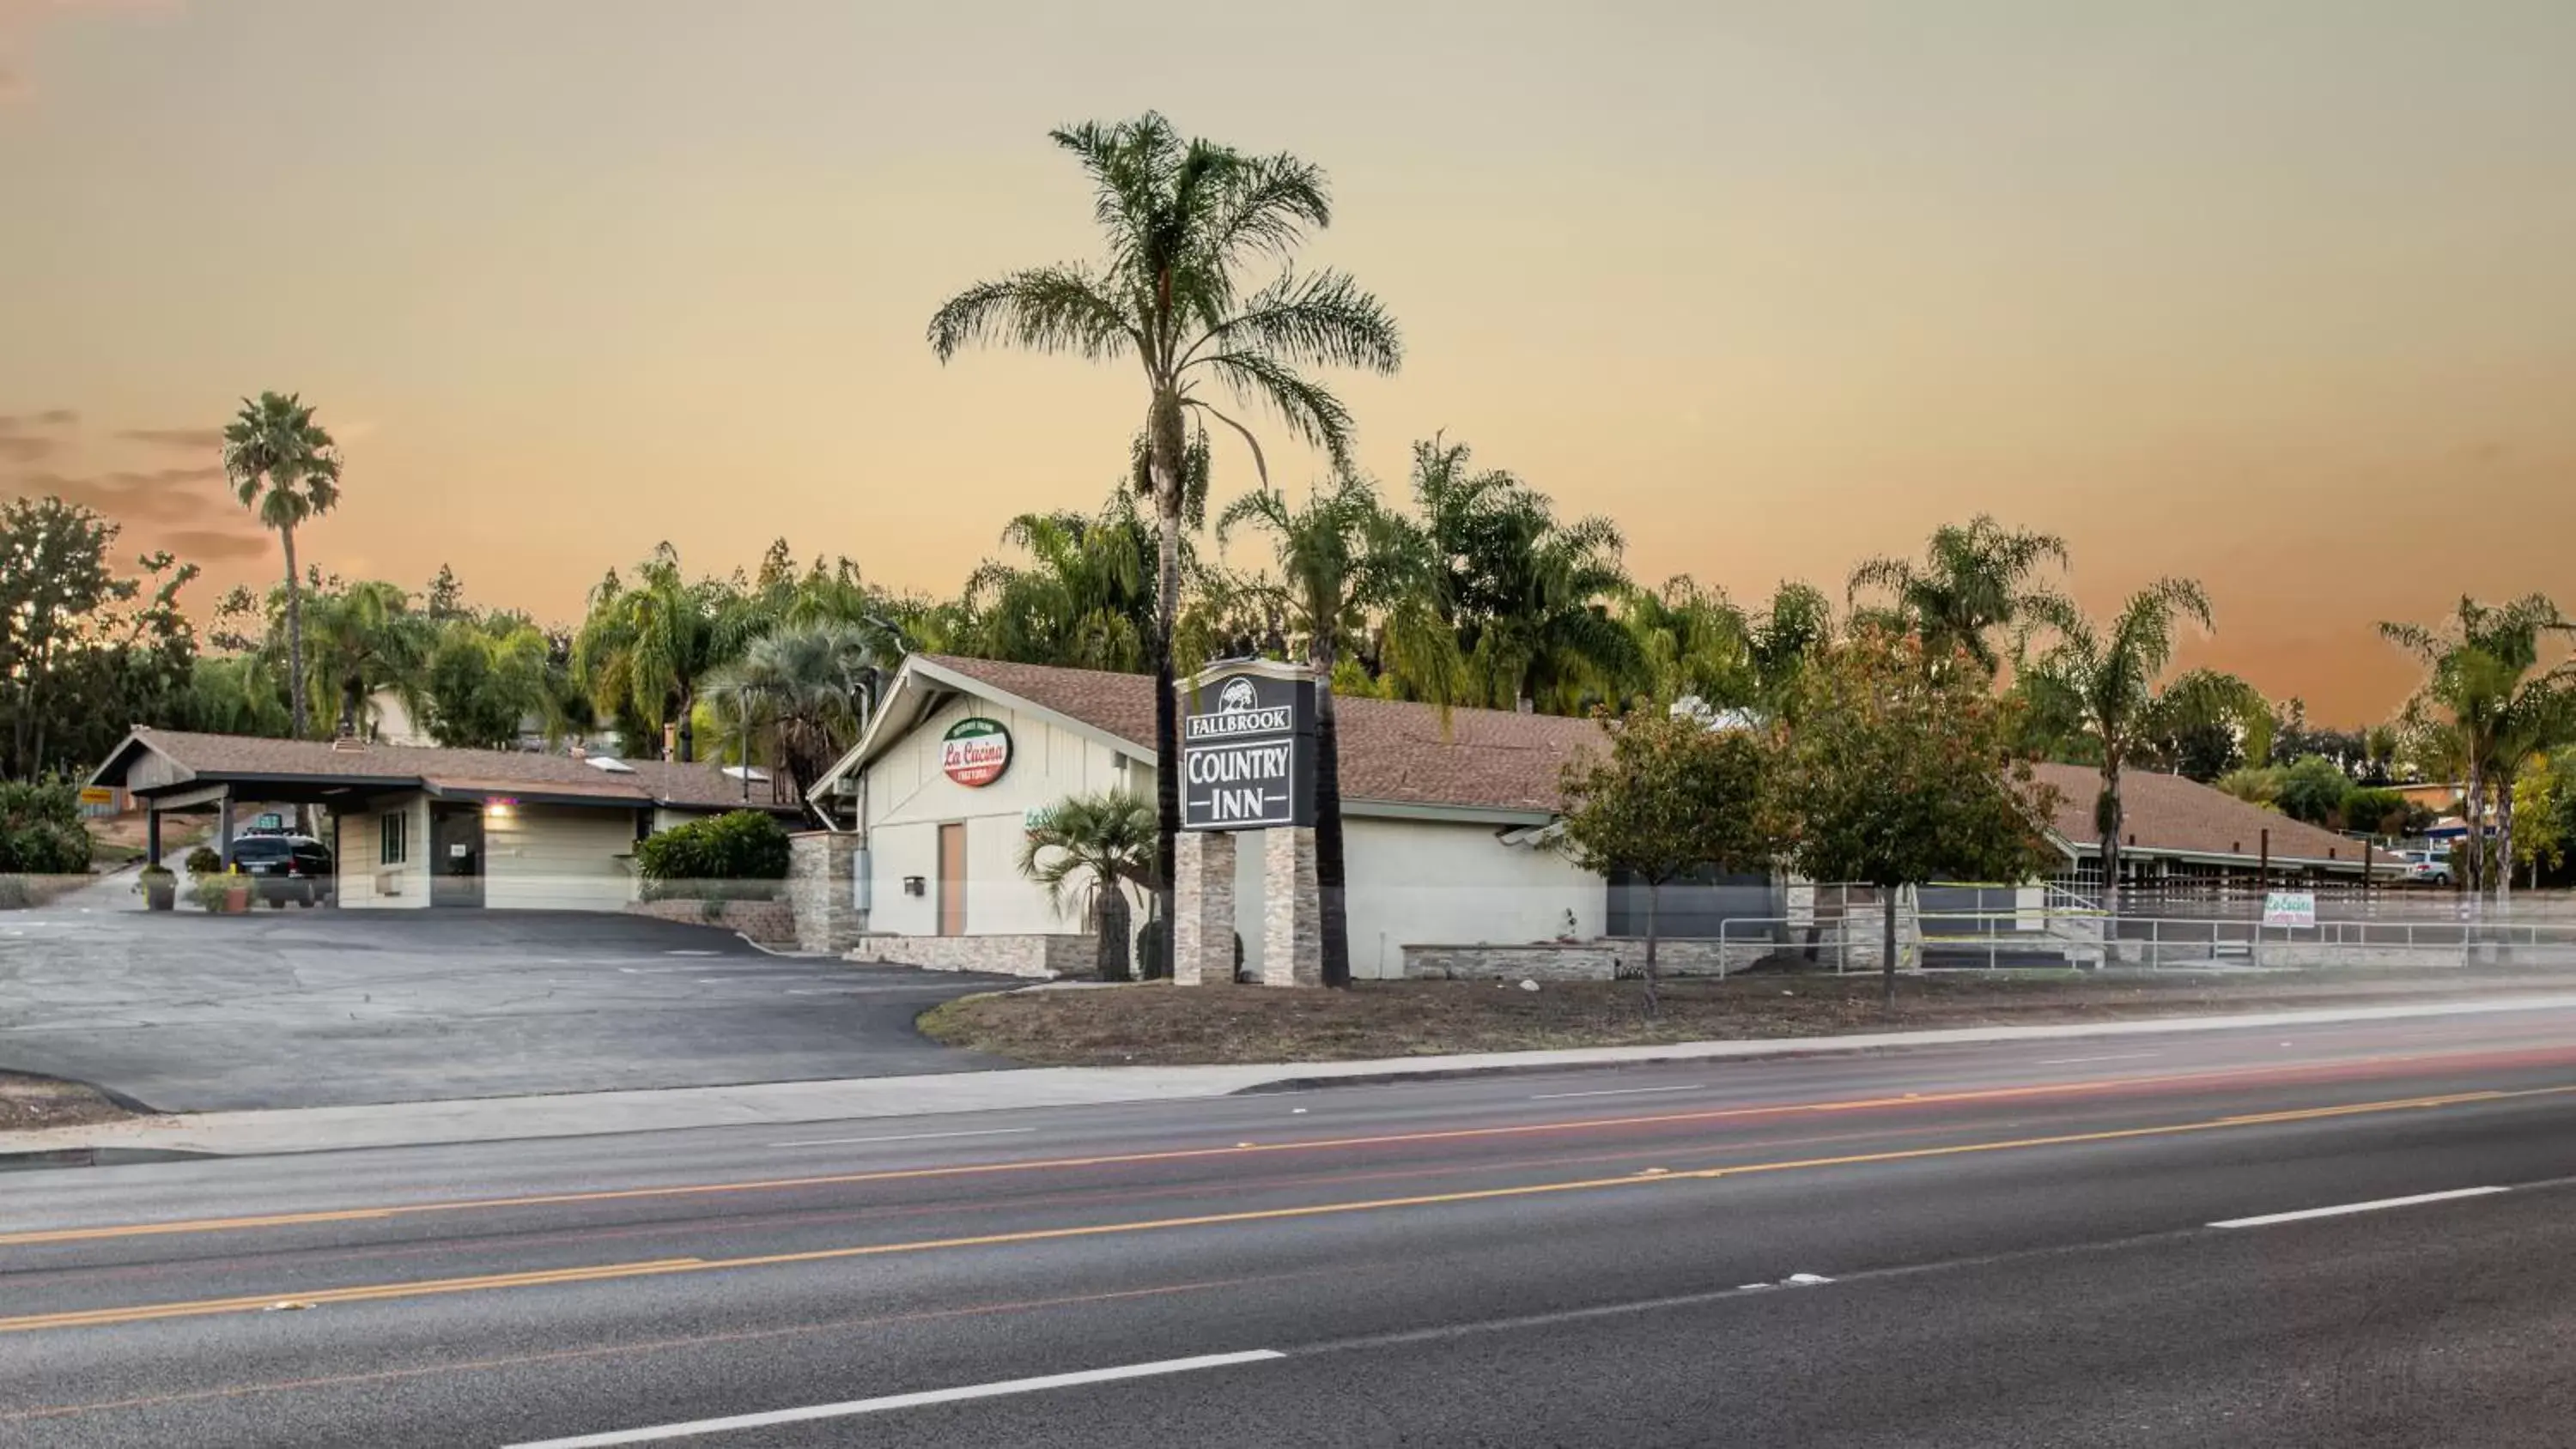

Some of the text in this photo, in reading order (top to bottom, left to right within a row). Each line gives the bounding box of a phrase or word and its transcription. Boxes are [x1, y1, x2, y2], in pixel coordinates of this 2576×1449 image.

[1193, 711, 1285, 735] FALLBROOK
[945, 743, 960, 767] La
[1188, 747, 1288, 784] COUNTRY
[1212, 788, 1263, 820] INN
